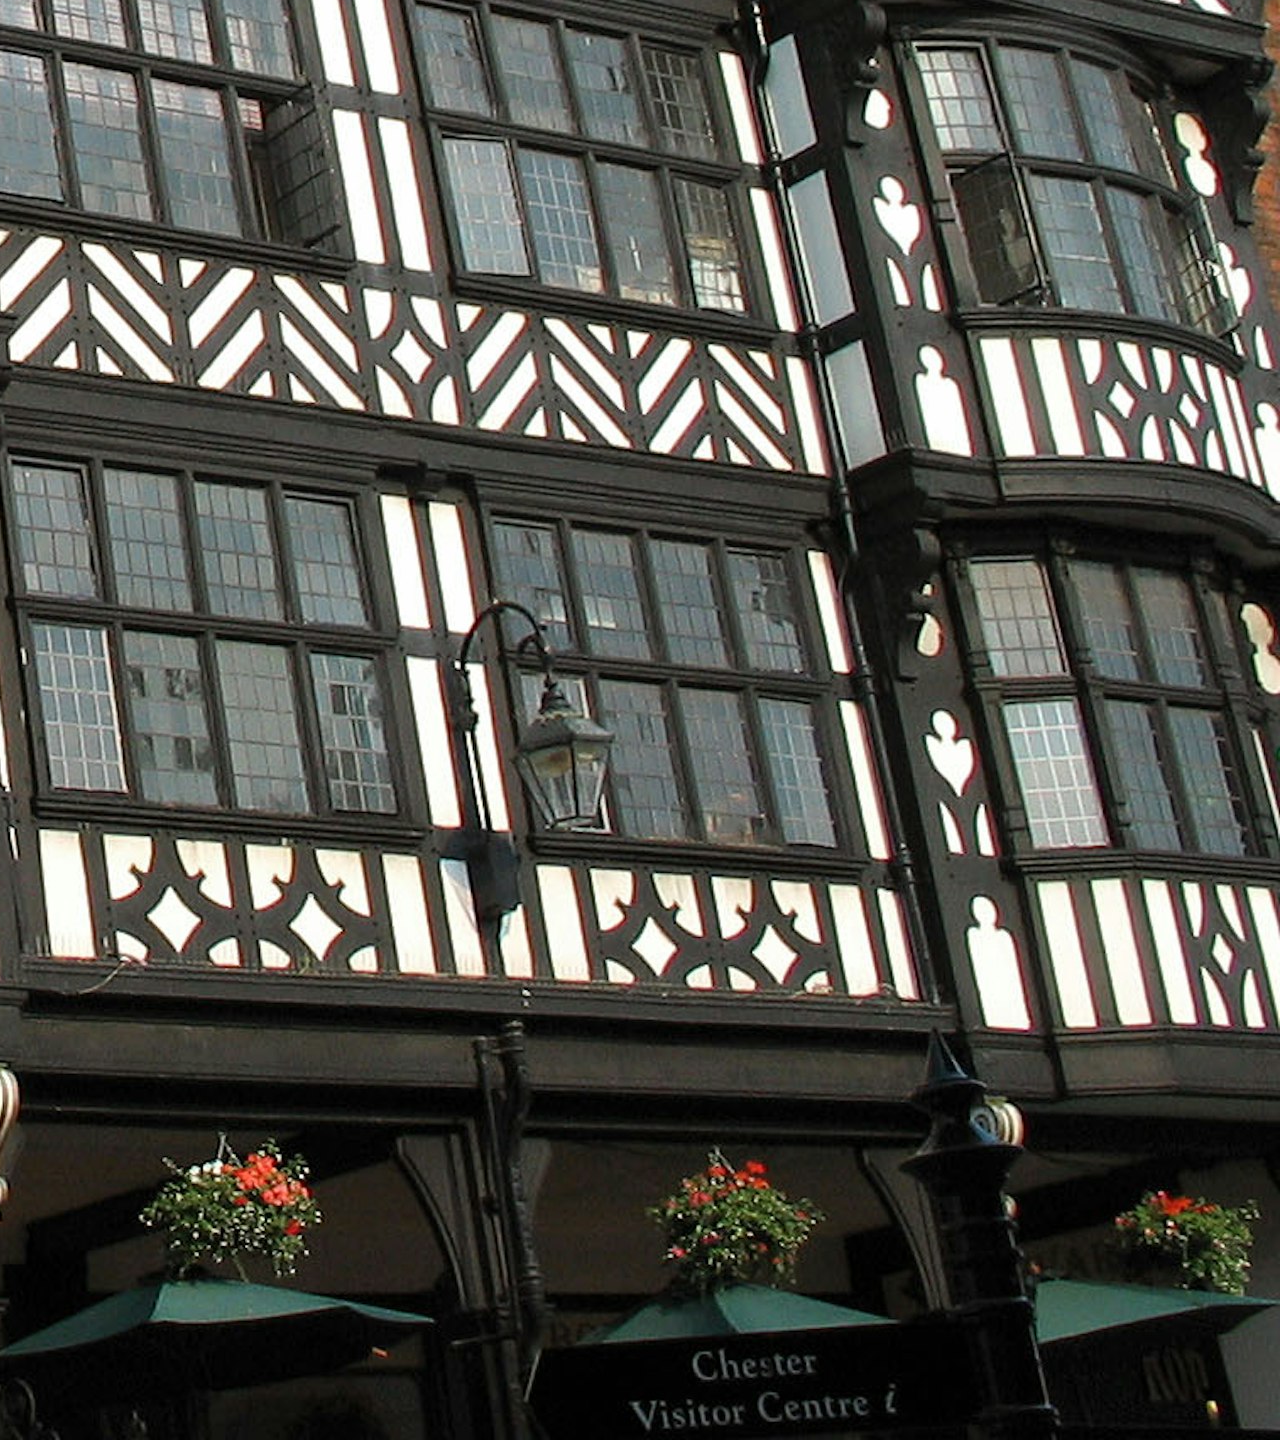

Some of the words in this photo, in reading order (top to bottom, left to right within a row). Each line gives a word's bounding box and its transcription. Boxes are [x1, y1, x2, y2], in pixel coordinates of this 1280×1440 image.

[691, 1349, 817, 1382] Chester
[628, 1398, 744, 1432] Visitor
[756, 1391, 869, 1423] Centre
